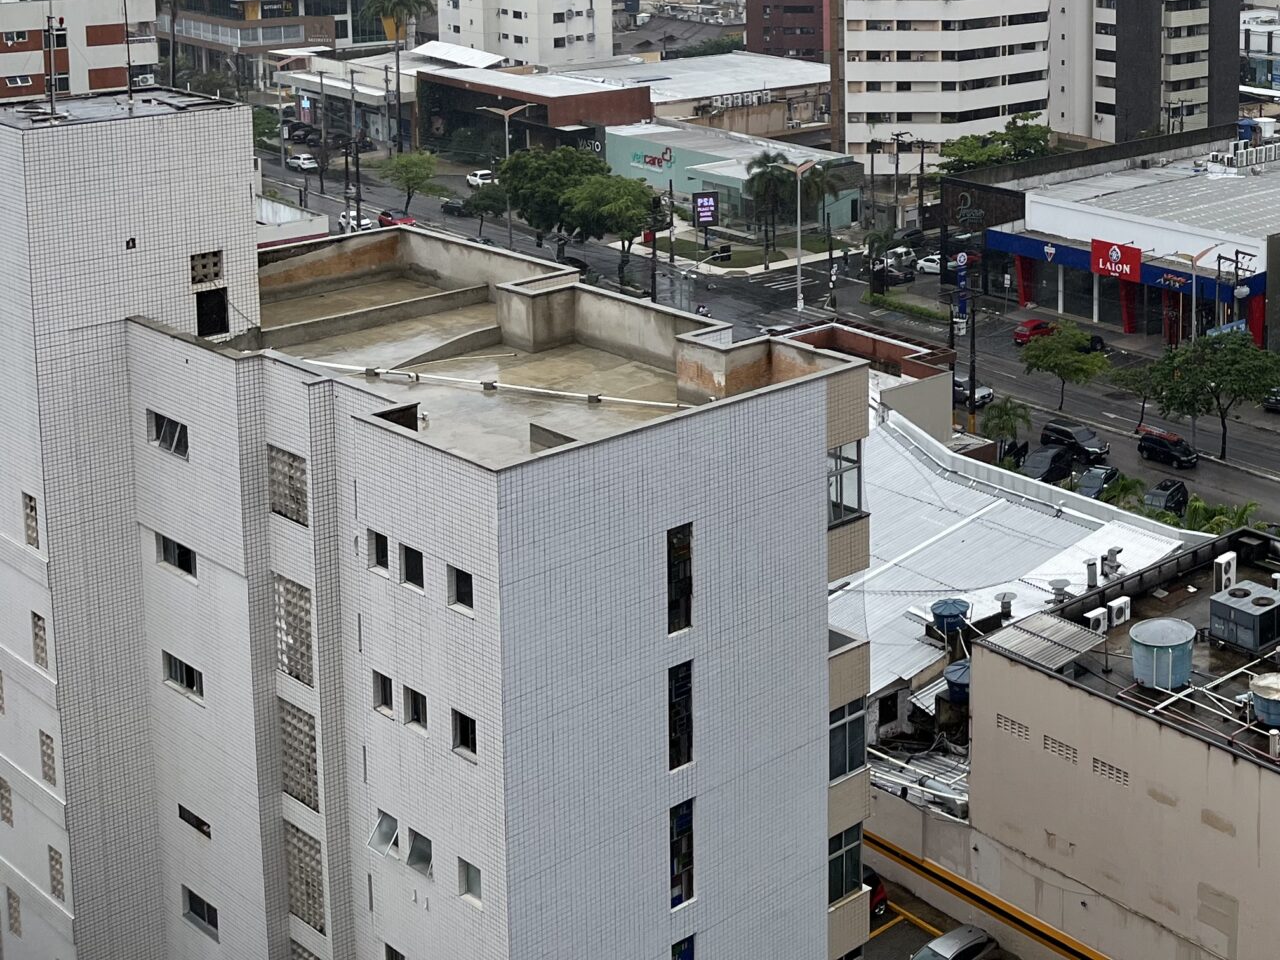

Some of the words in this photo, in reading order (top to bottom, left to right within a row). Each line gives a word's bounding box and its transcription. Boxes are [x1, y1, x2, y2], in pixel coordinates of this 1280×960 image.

[577, 137, 602, 152] VASTO
[697, 197, 714, 207] PSA
[1099, 258, 1130, 274] LAION
